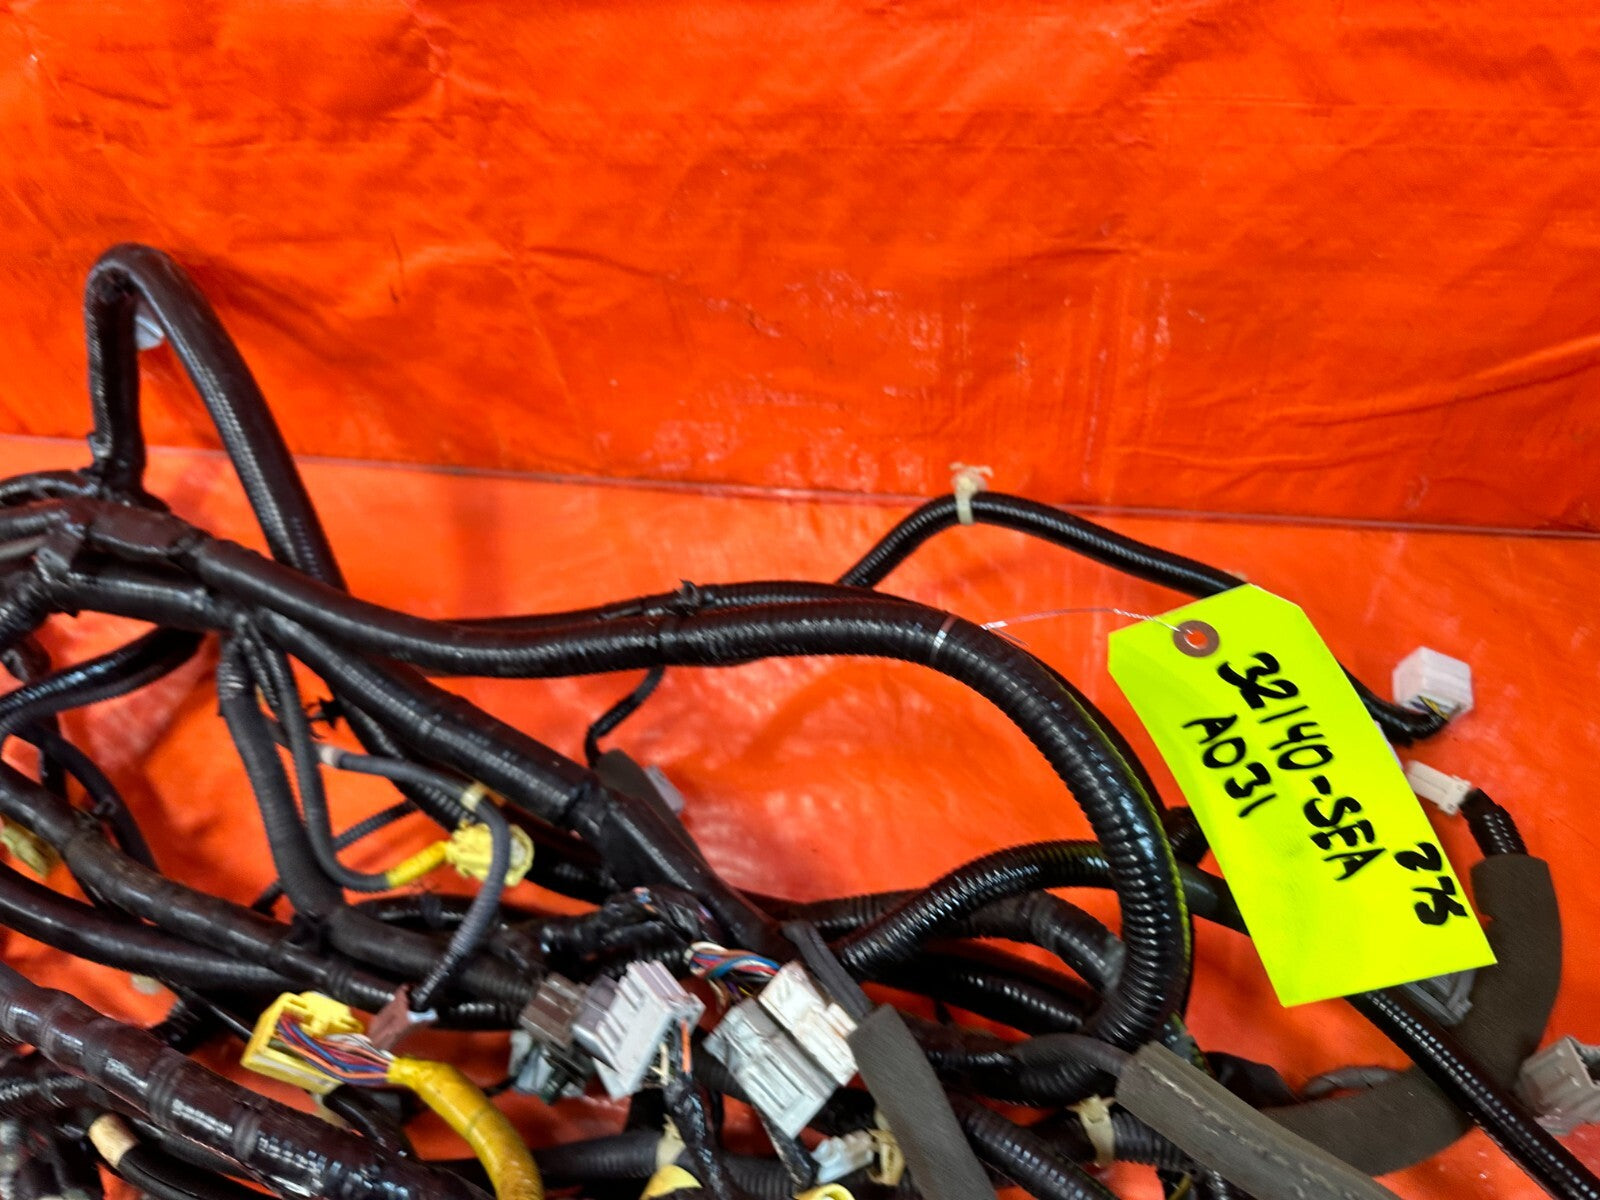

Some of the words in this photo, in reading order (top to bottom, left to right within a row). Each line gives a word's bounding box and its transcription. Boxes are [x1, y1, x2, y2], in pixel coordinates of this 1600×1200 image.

[1183, 714, 1277, 817] A031
[1217, 652, 1386, 880] 32140-SEA
[1395, 842, 1468, 925] 275
